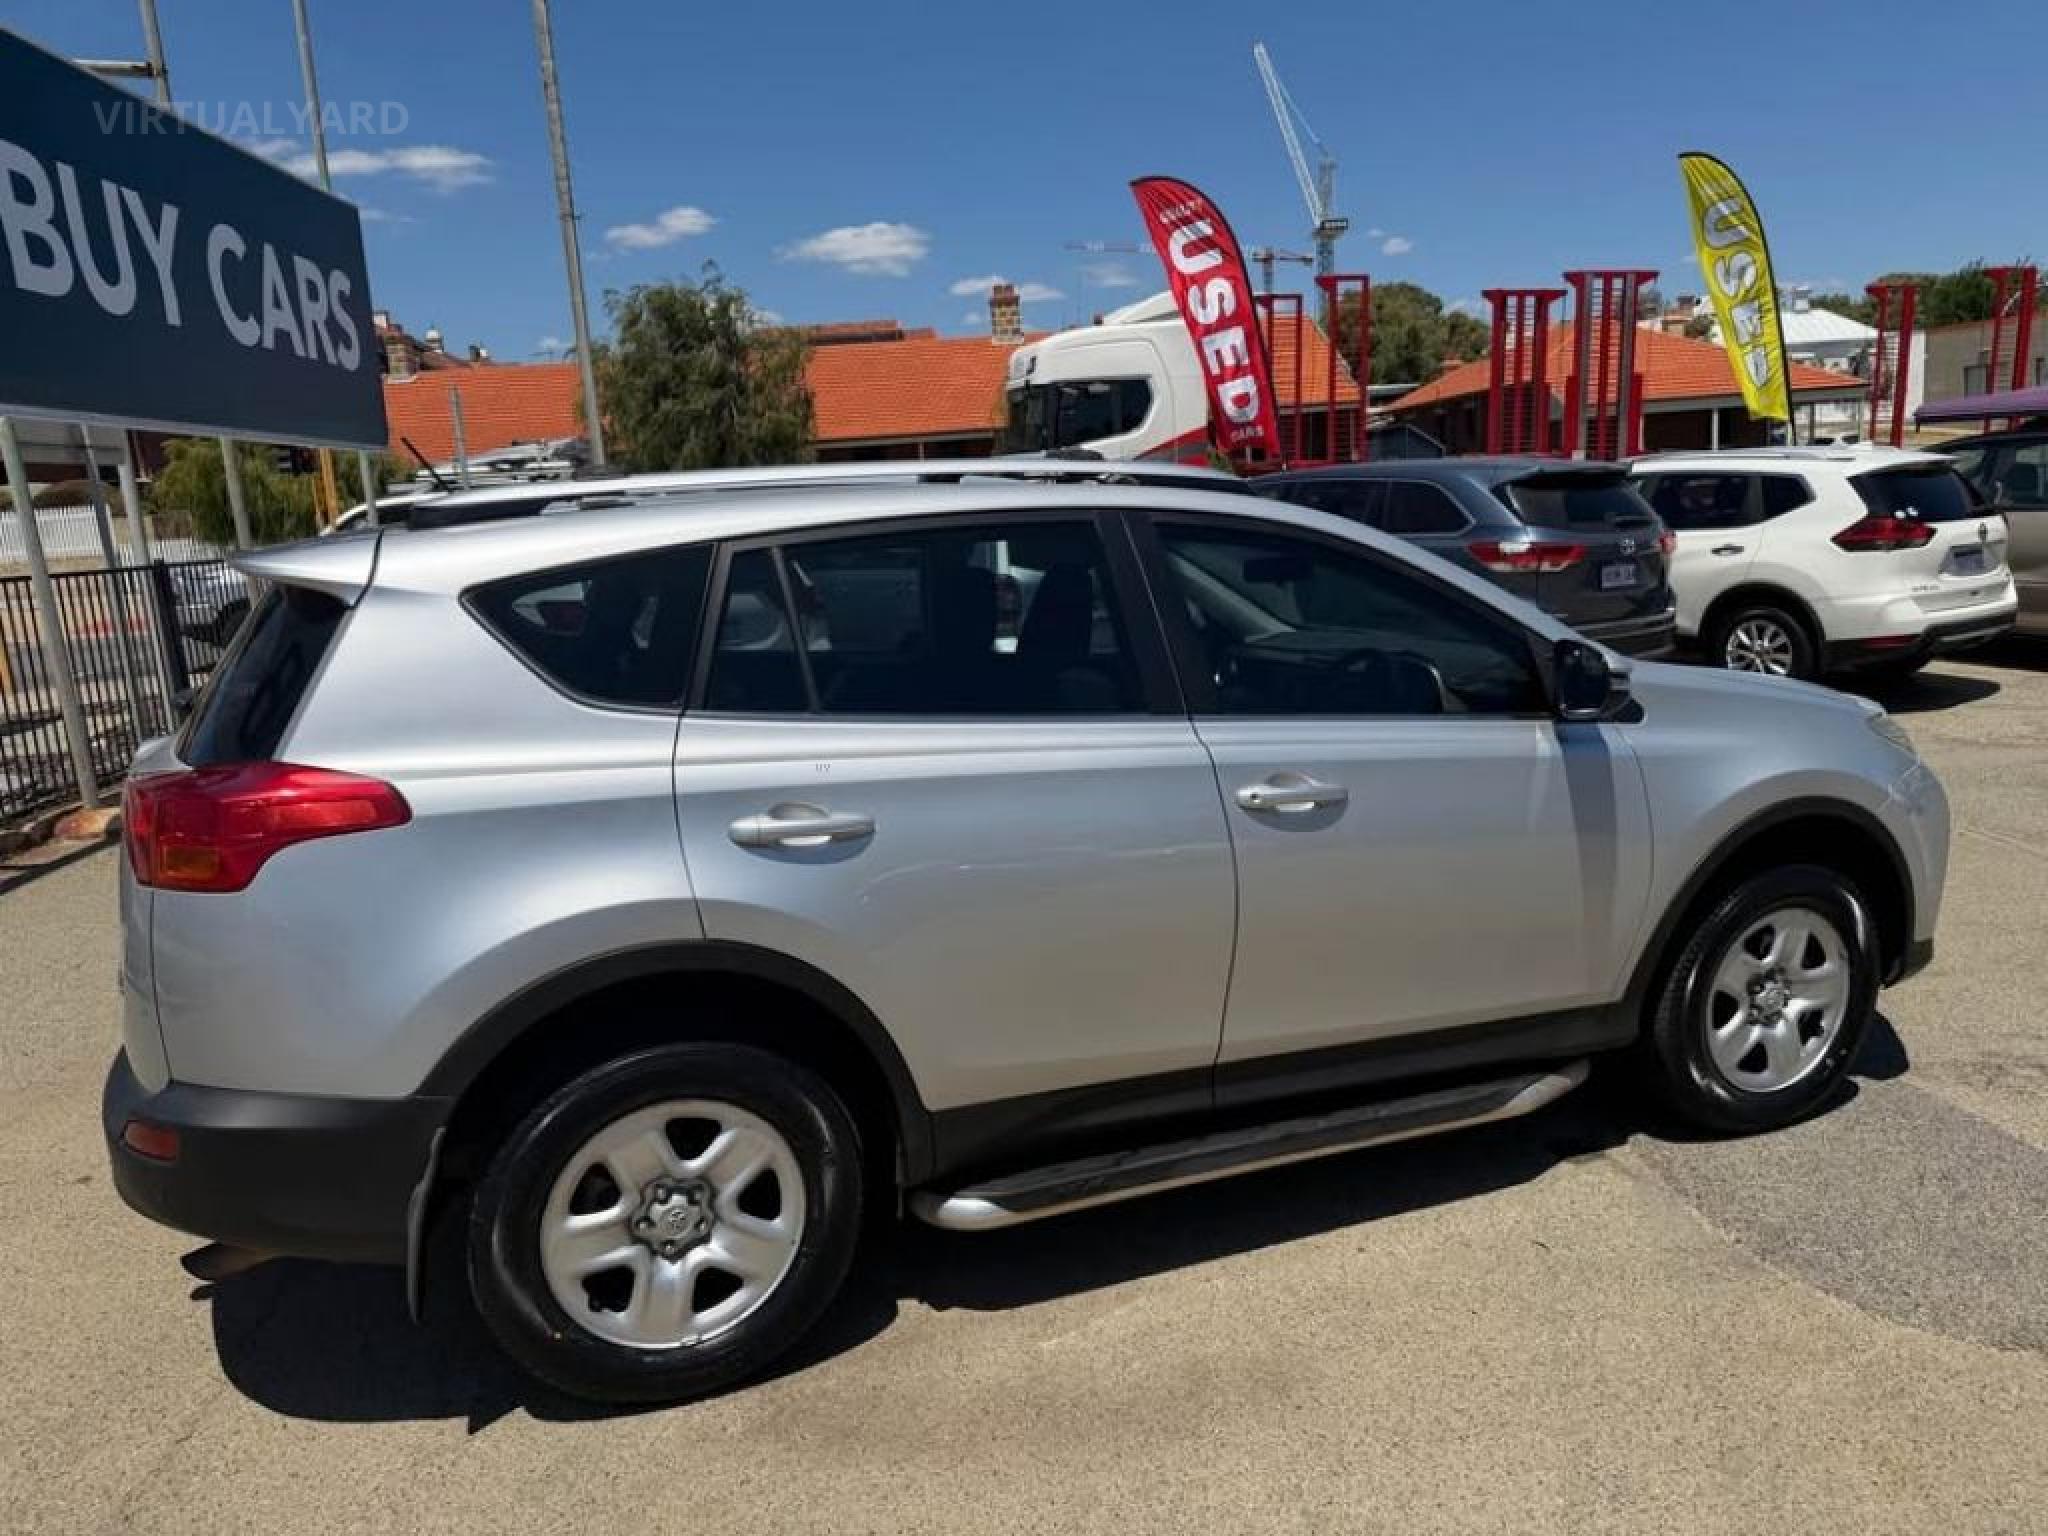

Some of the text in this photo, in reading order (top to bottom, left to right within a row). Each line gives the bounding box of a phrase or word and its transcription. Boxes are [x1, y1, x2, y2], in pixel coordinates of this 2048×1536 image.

[0, 138, 361, 372] BUY CARS
[1169, 218, 1260, 423] USED
